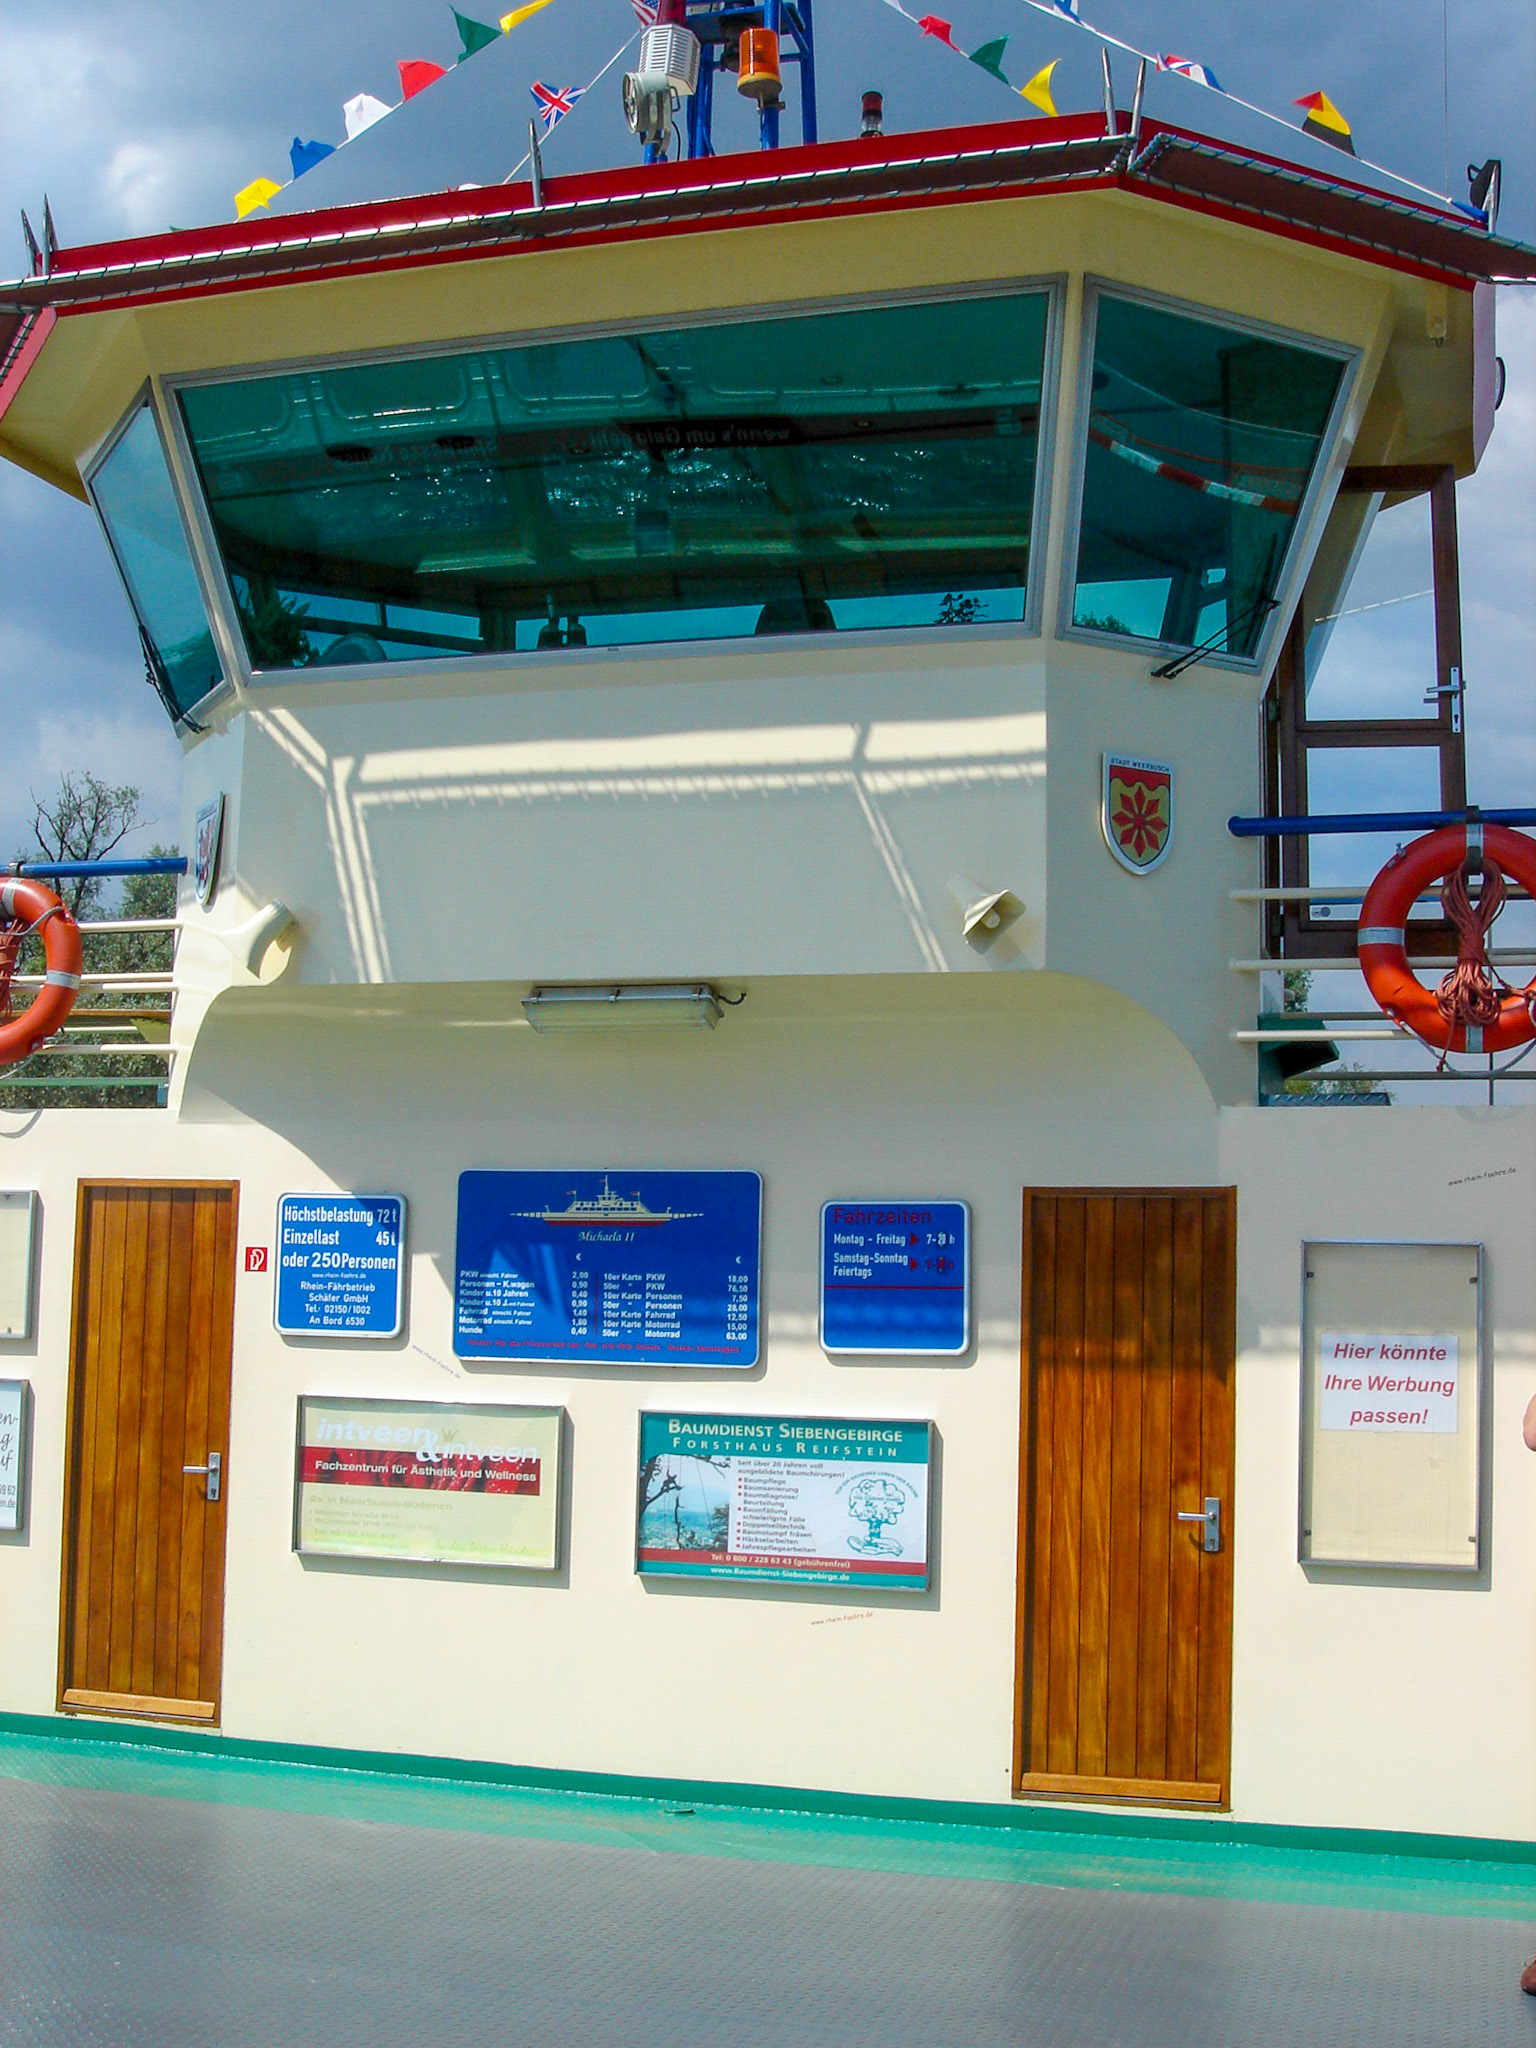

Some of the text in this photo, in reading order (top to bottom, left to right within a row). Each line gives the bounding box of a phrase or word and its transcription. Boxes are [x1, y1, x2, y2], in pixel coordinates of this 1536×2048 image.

[284, 1205, 397, 1227] Höchstbelastung 72 t
[284, 1228, 396, 1246] Einzellast 45 t
[578, 1231, 622, 1242] Michaela
[834, 1233, 865, 1247] Montag
[876, 1233, 906, 1247] Freitag
[282, 1252, 396, 1269] oder 250 Personen
[834, 1252, 909, 1266] Samstag-Sonntag
[460, 1270, 479, 1278] PKW
[604, 1273, 621, 1281] 10er
[621, 1273, 642, 1281] Karte
[646, 1273, 666, 1281] PKW
[833, 1266, 873, 1279] Feiertags
[301, 1281, 376, 1291] Rhein-Fährbetrieb
[460, 1280, 495, 1288] Personen
[603, 1282, 620, 1290] 50er
[646, 1282, 666, 1291] PKW
[309, 1292, 369, 1303] Schäfer GmbH
[460, 1289, 484, 1297] Kinder
[502, 1289, 529, 1298] Jahren
[603, 1292, 620, 1300] 10er
[621, 1292, 642, 1300] Karte
[645, 1292, 683, 1301] Personen
[460, 1298, 484, 1306] Kinder
[603, 1301, 620, 1309] 50er
[645, 1301, 683, 1310] Personen
[459, 1307, 489, 1316] Fahrrad
[603, 1310, 620, 1319] 10er
[620, 1310, 642, 1319] Karte
[645, 1310, 676, 1319] Fahrrad
[309, 1315, 365, 1326] An Bord 6530
[459, 1316, 492, 1325] Motorrad
[602, 1320, 620, 1328] 10er
[620, 1320, 642, 1329] Karte
[644, 1320, 681, 1329] Motorrad
[459, 1325, 483, 1334] Hunde
[602, 1329, 620, 1338] 50er
[644, 1329, 681, 1339] Motorrad
[1333, 1343, 1447, 1361] Hier könnte
[1324, 1374, 1455, 1397] Ihre Werbung
[1349, 1408, 1429, 1426] passen!
[317, 1418, 436, 1444] intveen
[668, 1418, 903, 1442] BAUMDIENST SIEBENGEBIRGE
[442, 1441, 538, 1464] intveen
[315, 1460, 537, 1482] Fachzentrum für Ästhetik und Wellness
[786, 1470, 845, 1478] Baumchirurgen!
[744, 1477, 786, 1485] Baumpflege
[744, 1485, 799, 1493] Baumsanierung
[743, 1507, 788, 1515] Baumfällung
[743, 1514, 787, 1522] schwierigste
[742, 1522, 806, 1530] Doppelseiltechnik
[742, 1529, 788, 1538] Baumstumpf
[742, 1537, 799, 1545] Häckselarbeiten
[741, 1544, 817, 1553] Jahrespflegearbeiten
[725, 1554, 731, 1562] 0
[732, 1554, 747, 1563] 800
[793, 1558, 851, 1568] (gebührenfrei)
